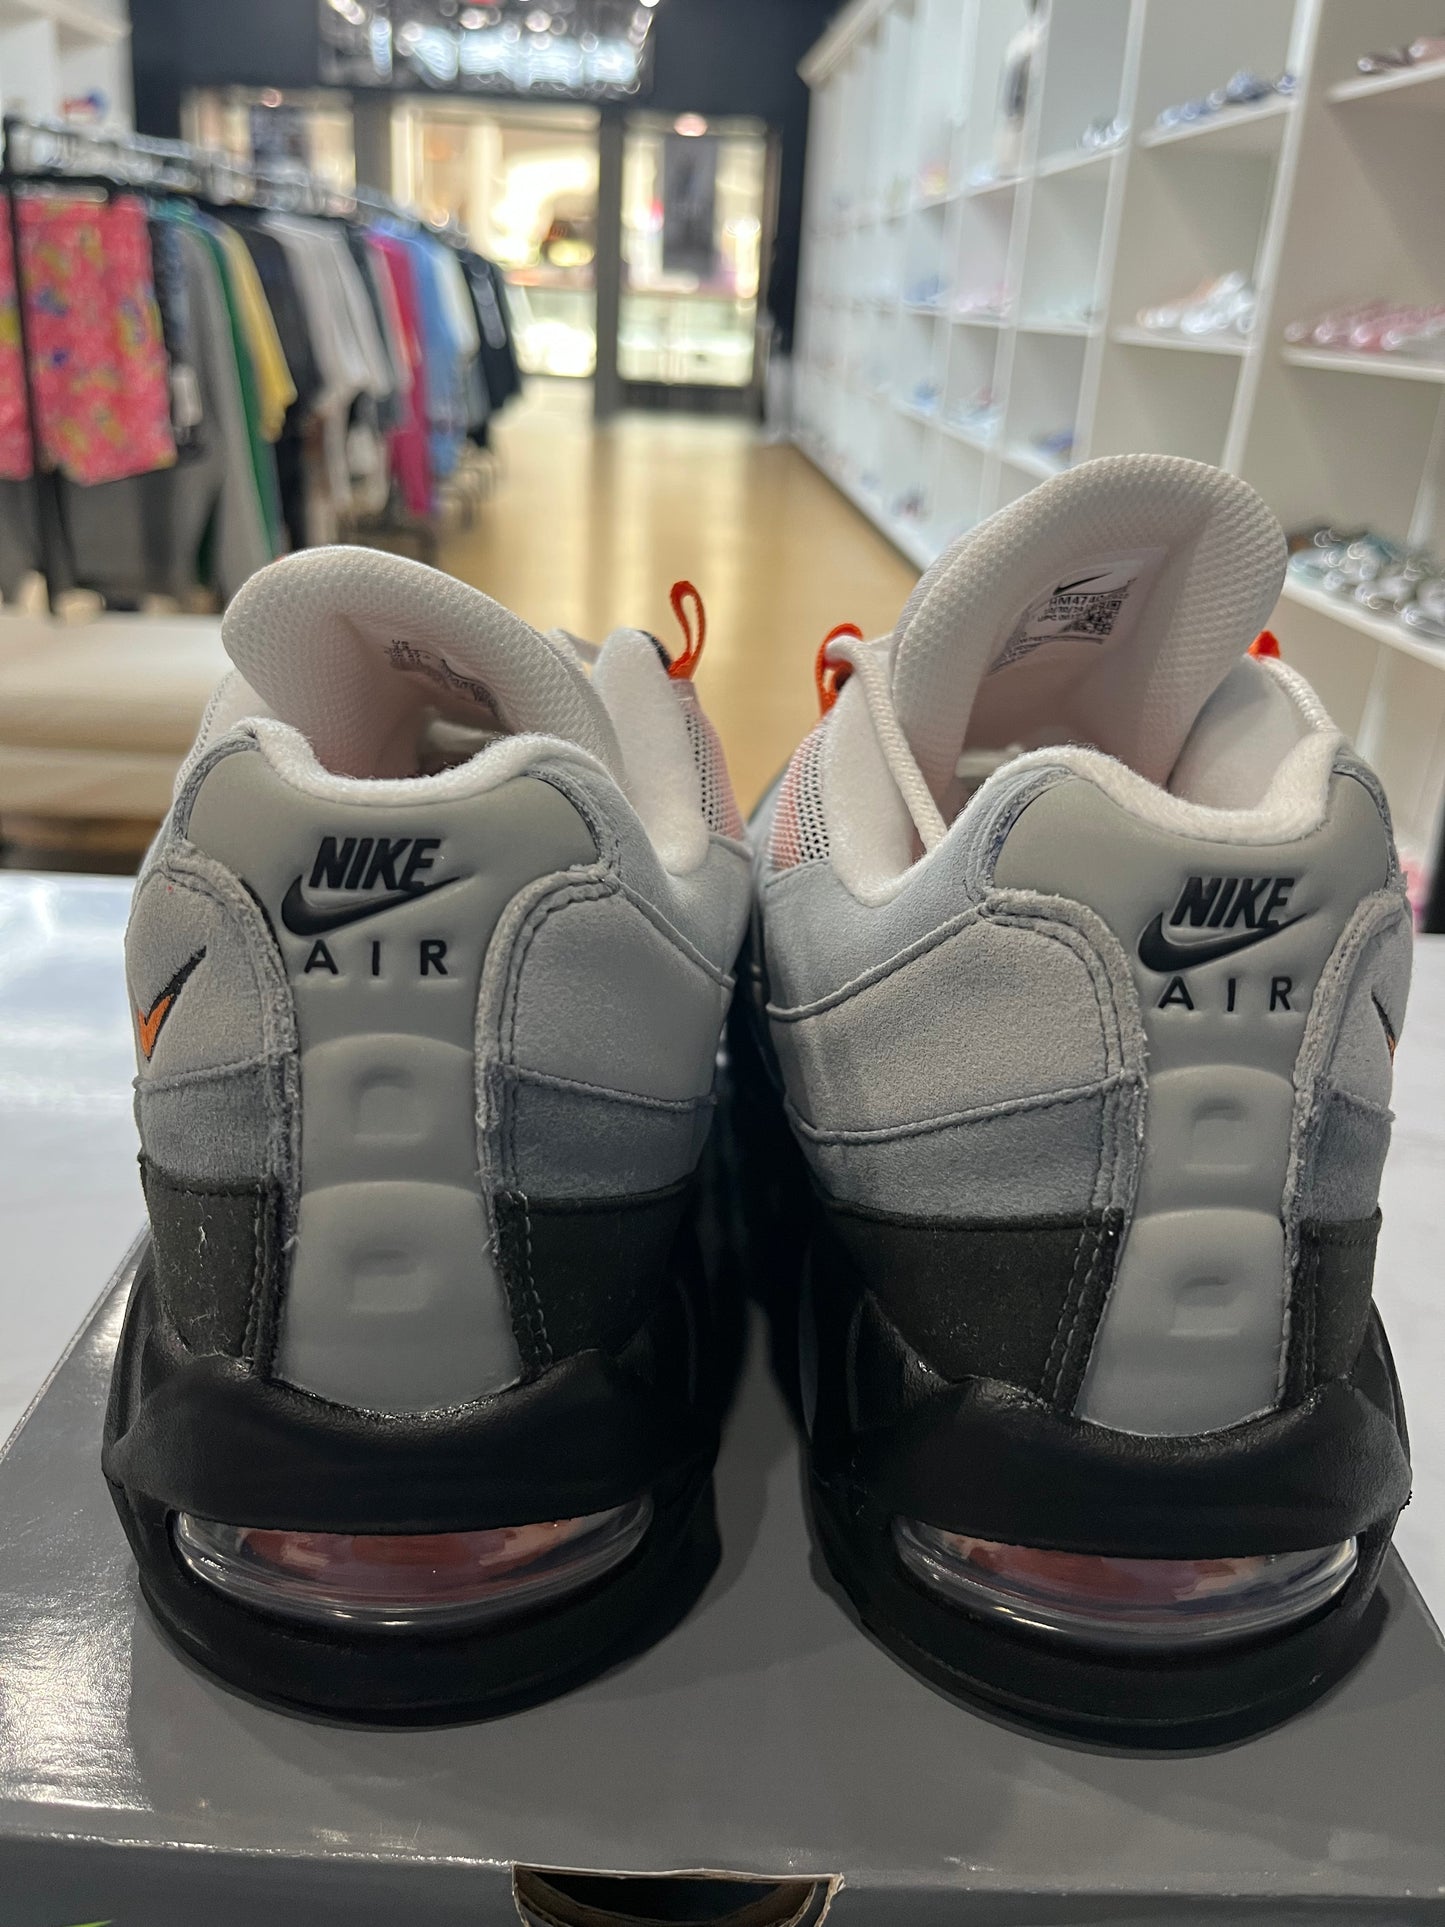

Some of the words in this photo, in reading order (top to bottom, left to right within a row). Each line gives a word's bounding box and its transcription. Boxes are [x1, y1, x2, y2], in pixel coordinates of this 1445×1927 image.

[309, 836, 442, 892] NIKE
[1169, 876, 1296, 929] NIKE
[303, 939, 449, 976] AIR
[1158, 975, 1293, 1012] AIR
